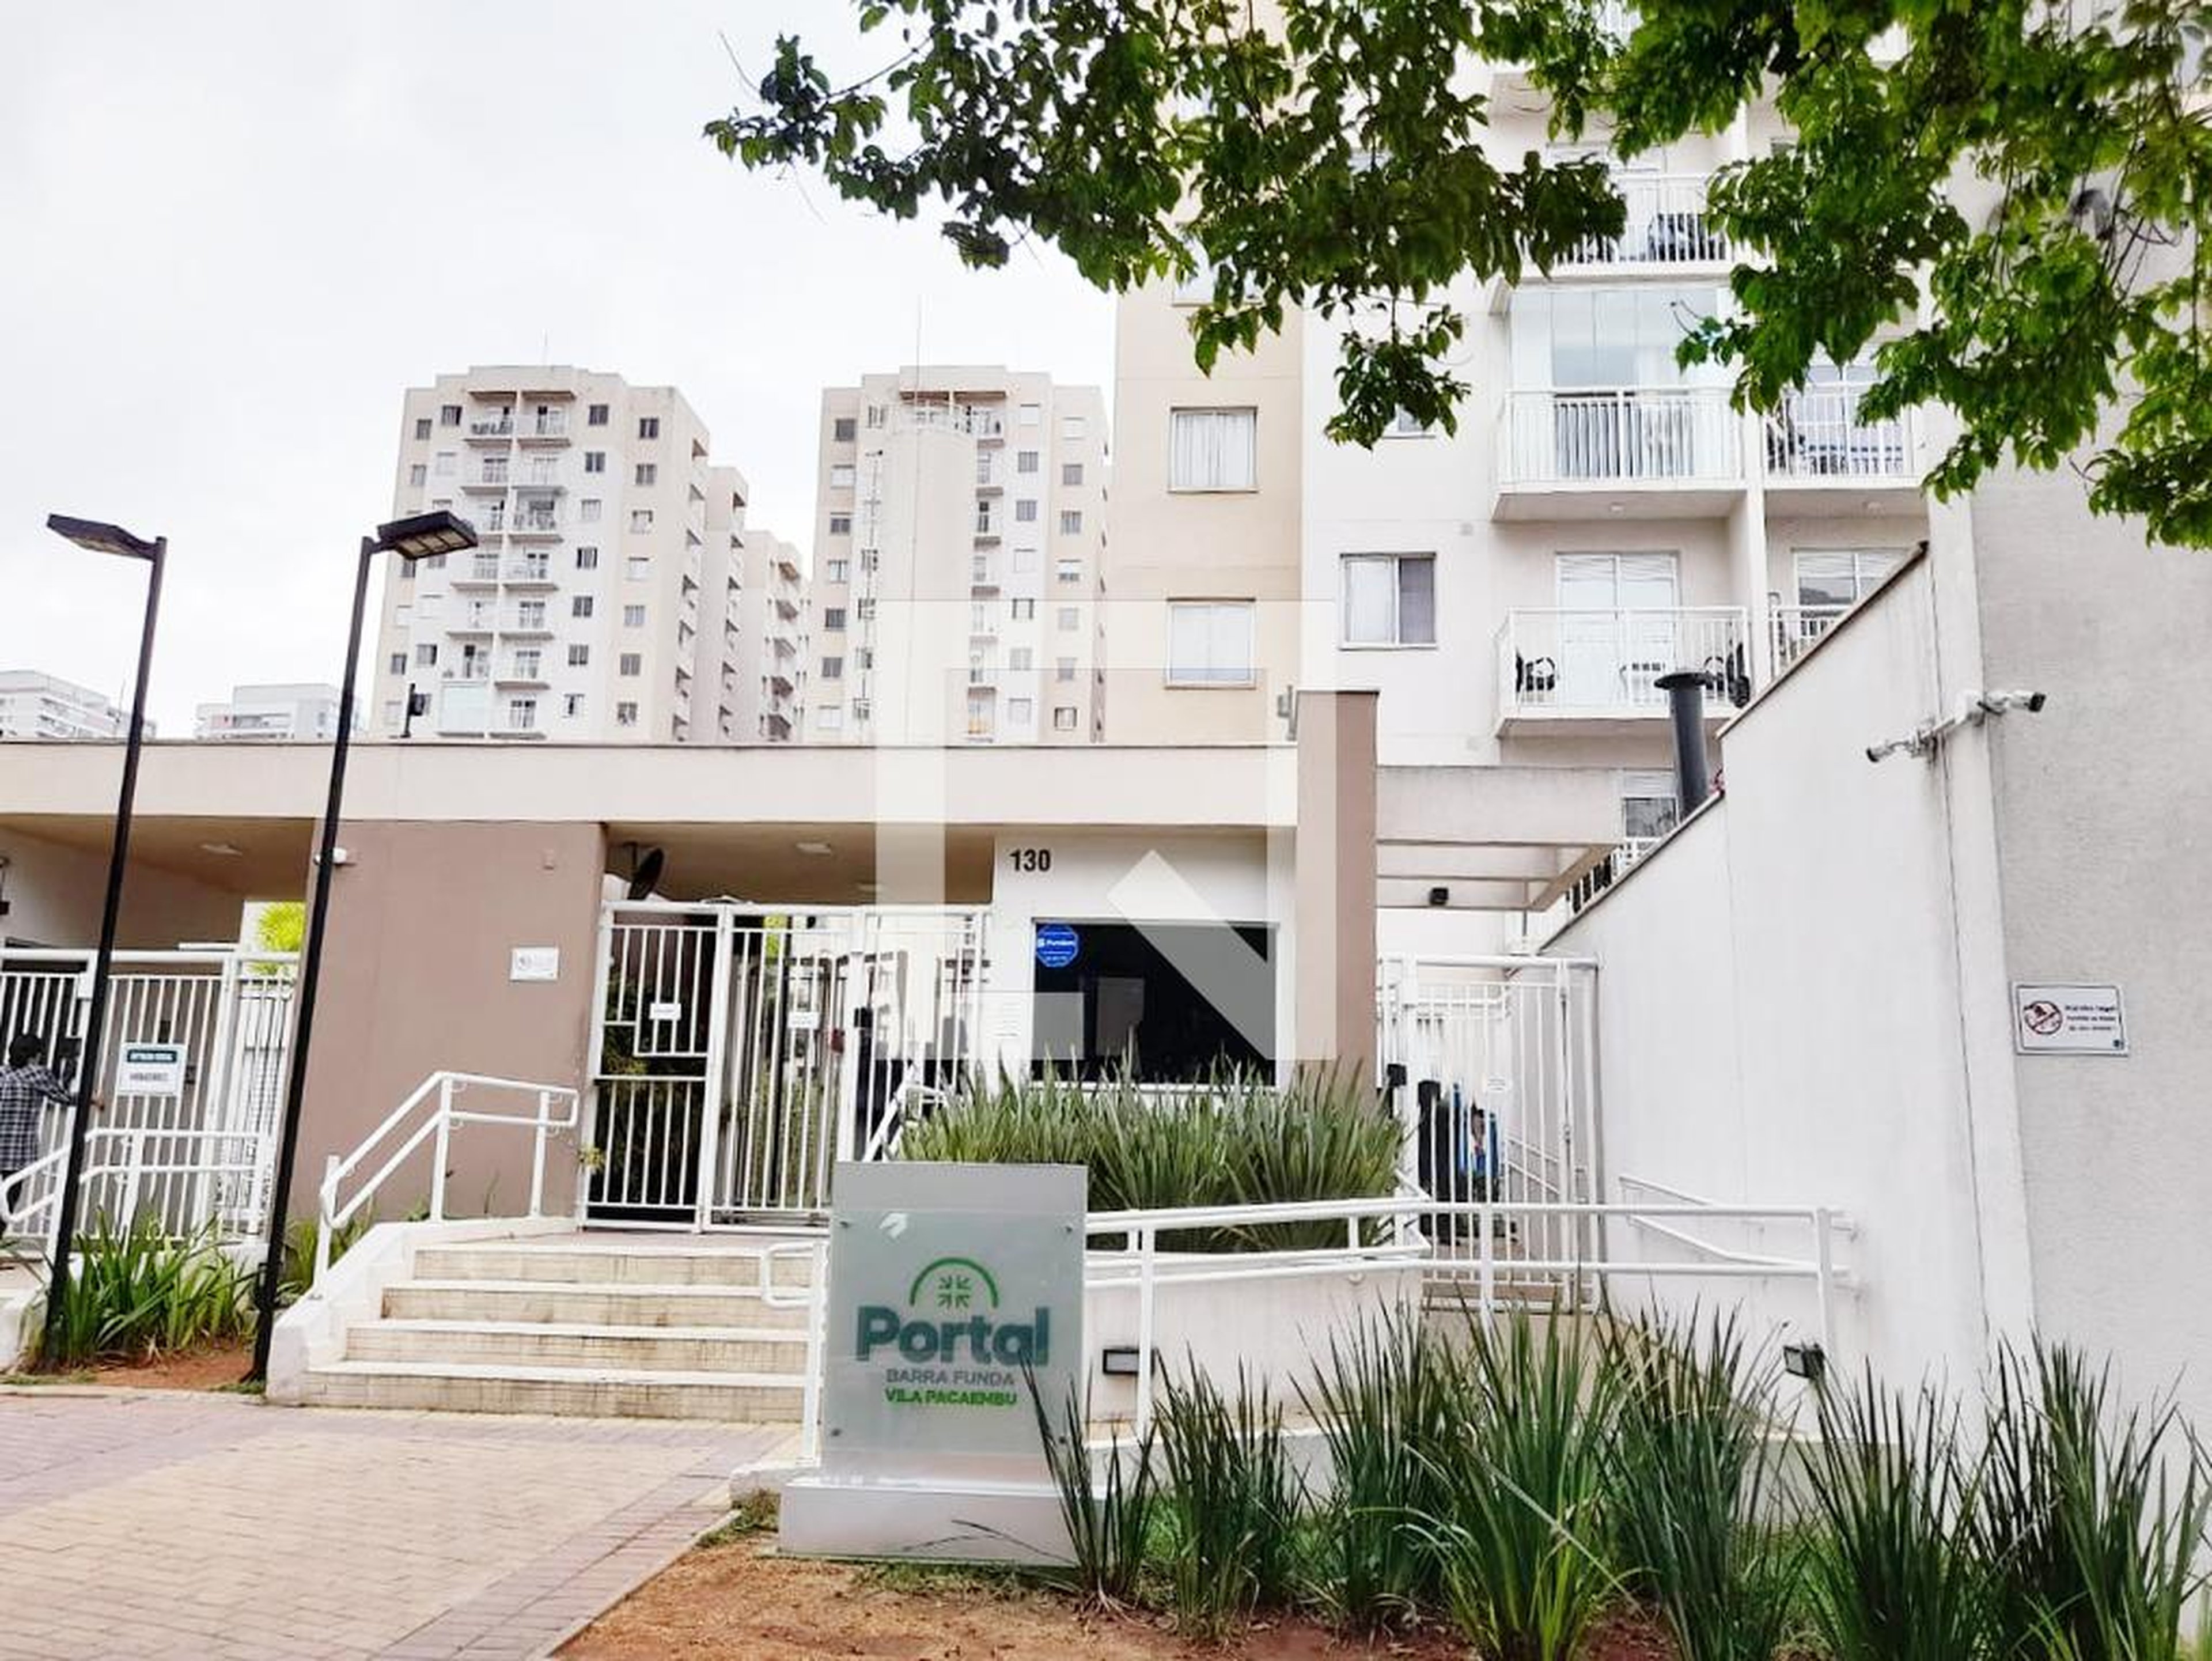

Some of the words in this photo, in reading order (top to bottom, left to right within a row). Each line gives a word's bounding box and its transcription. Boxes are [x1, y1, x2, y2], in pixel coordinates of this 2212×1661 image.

[1010, 849, 1051, 871] 130
[855, 1305, 1051, 1365] Portal
[886, 1369, 948, 1384] BARRA
[953, 1371, 1015, 1386] FUNDA
[885, 1387, 922, 1403] VILA
[925, 1390, 1017, 1406] PACAEMBU
